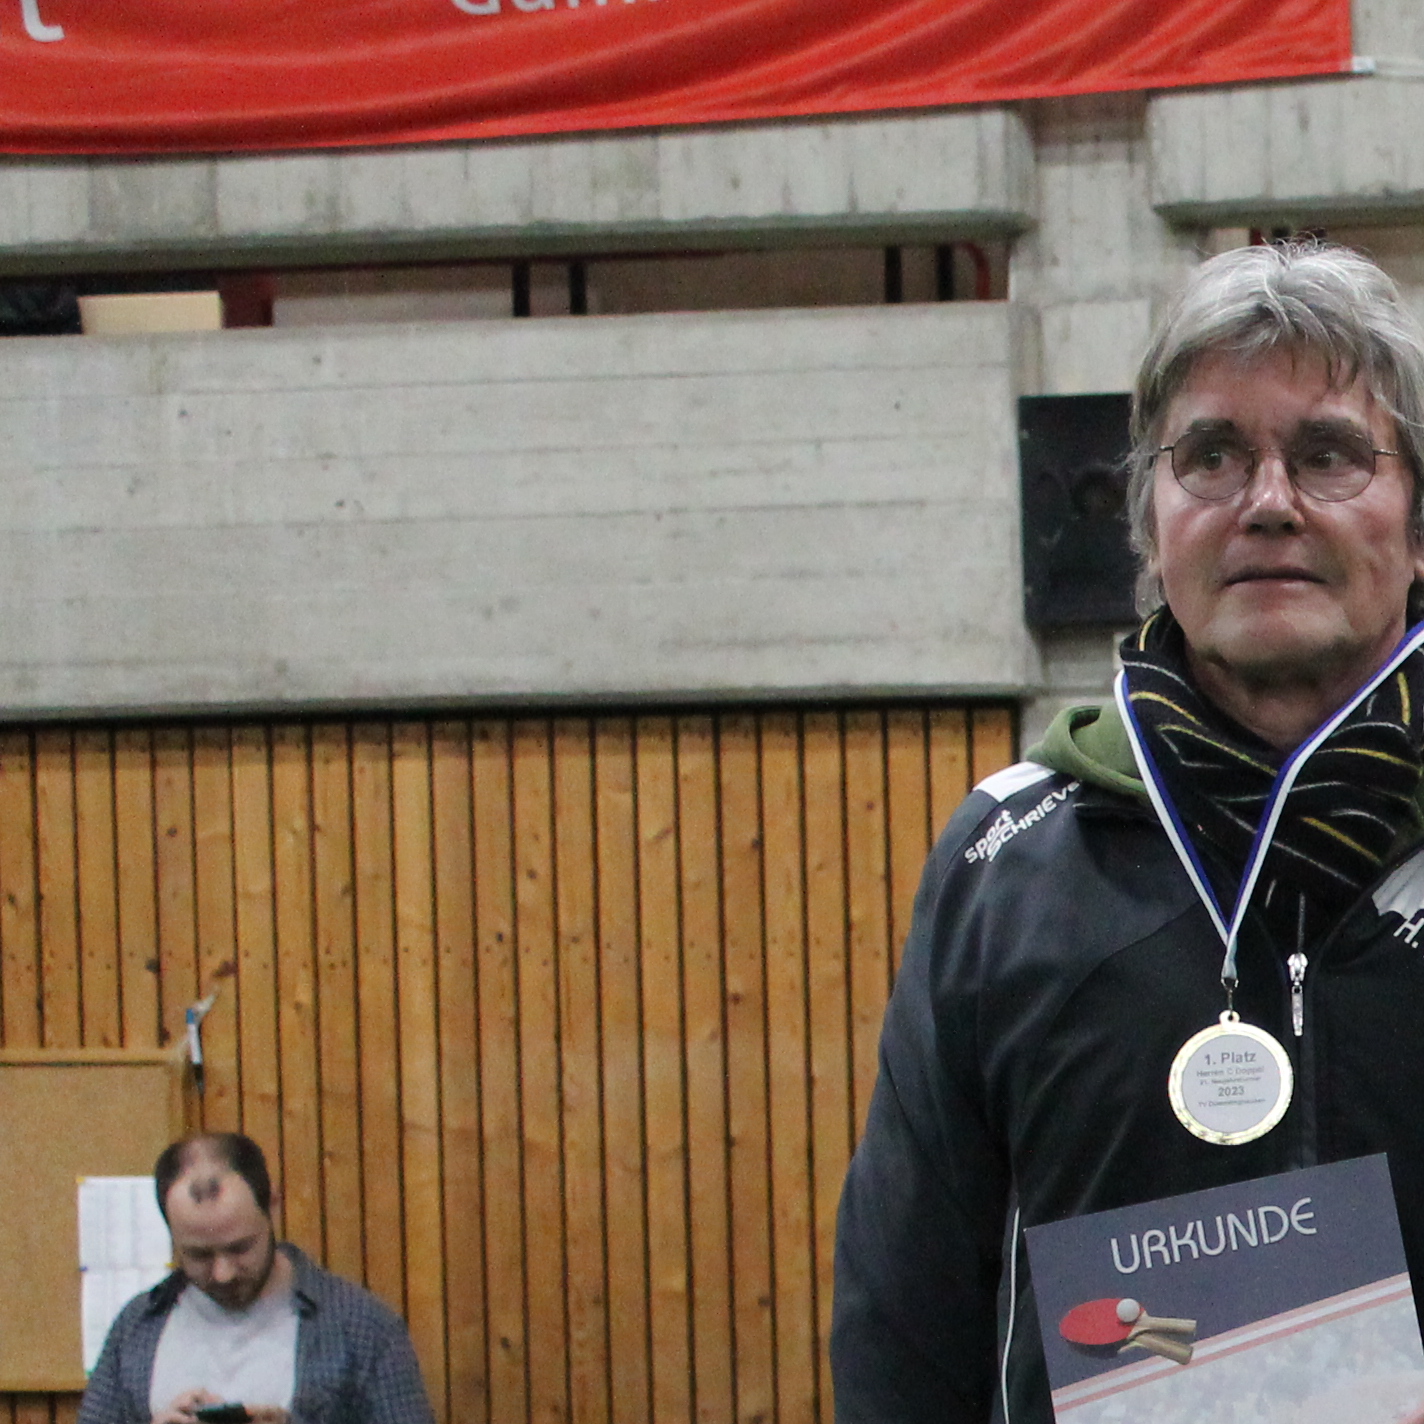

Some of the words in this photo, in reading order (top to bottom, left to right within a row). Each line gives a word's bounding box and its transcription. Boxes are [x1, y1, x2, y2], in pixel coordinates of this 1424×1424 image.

[1204, 1054, 1216, 1065] 1.
[1221, 1051, 1257, 1063] Platz
[1218, 1086, 1245, 1097] 2023
[1110, 1197, 1317, 1274] URKUNDE
